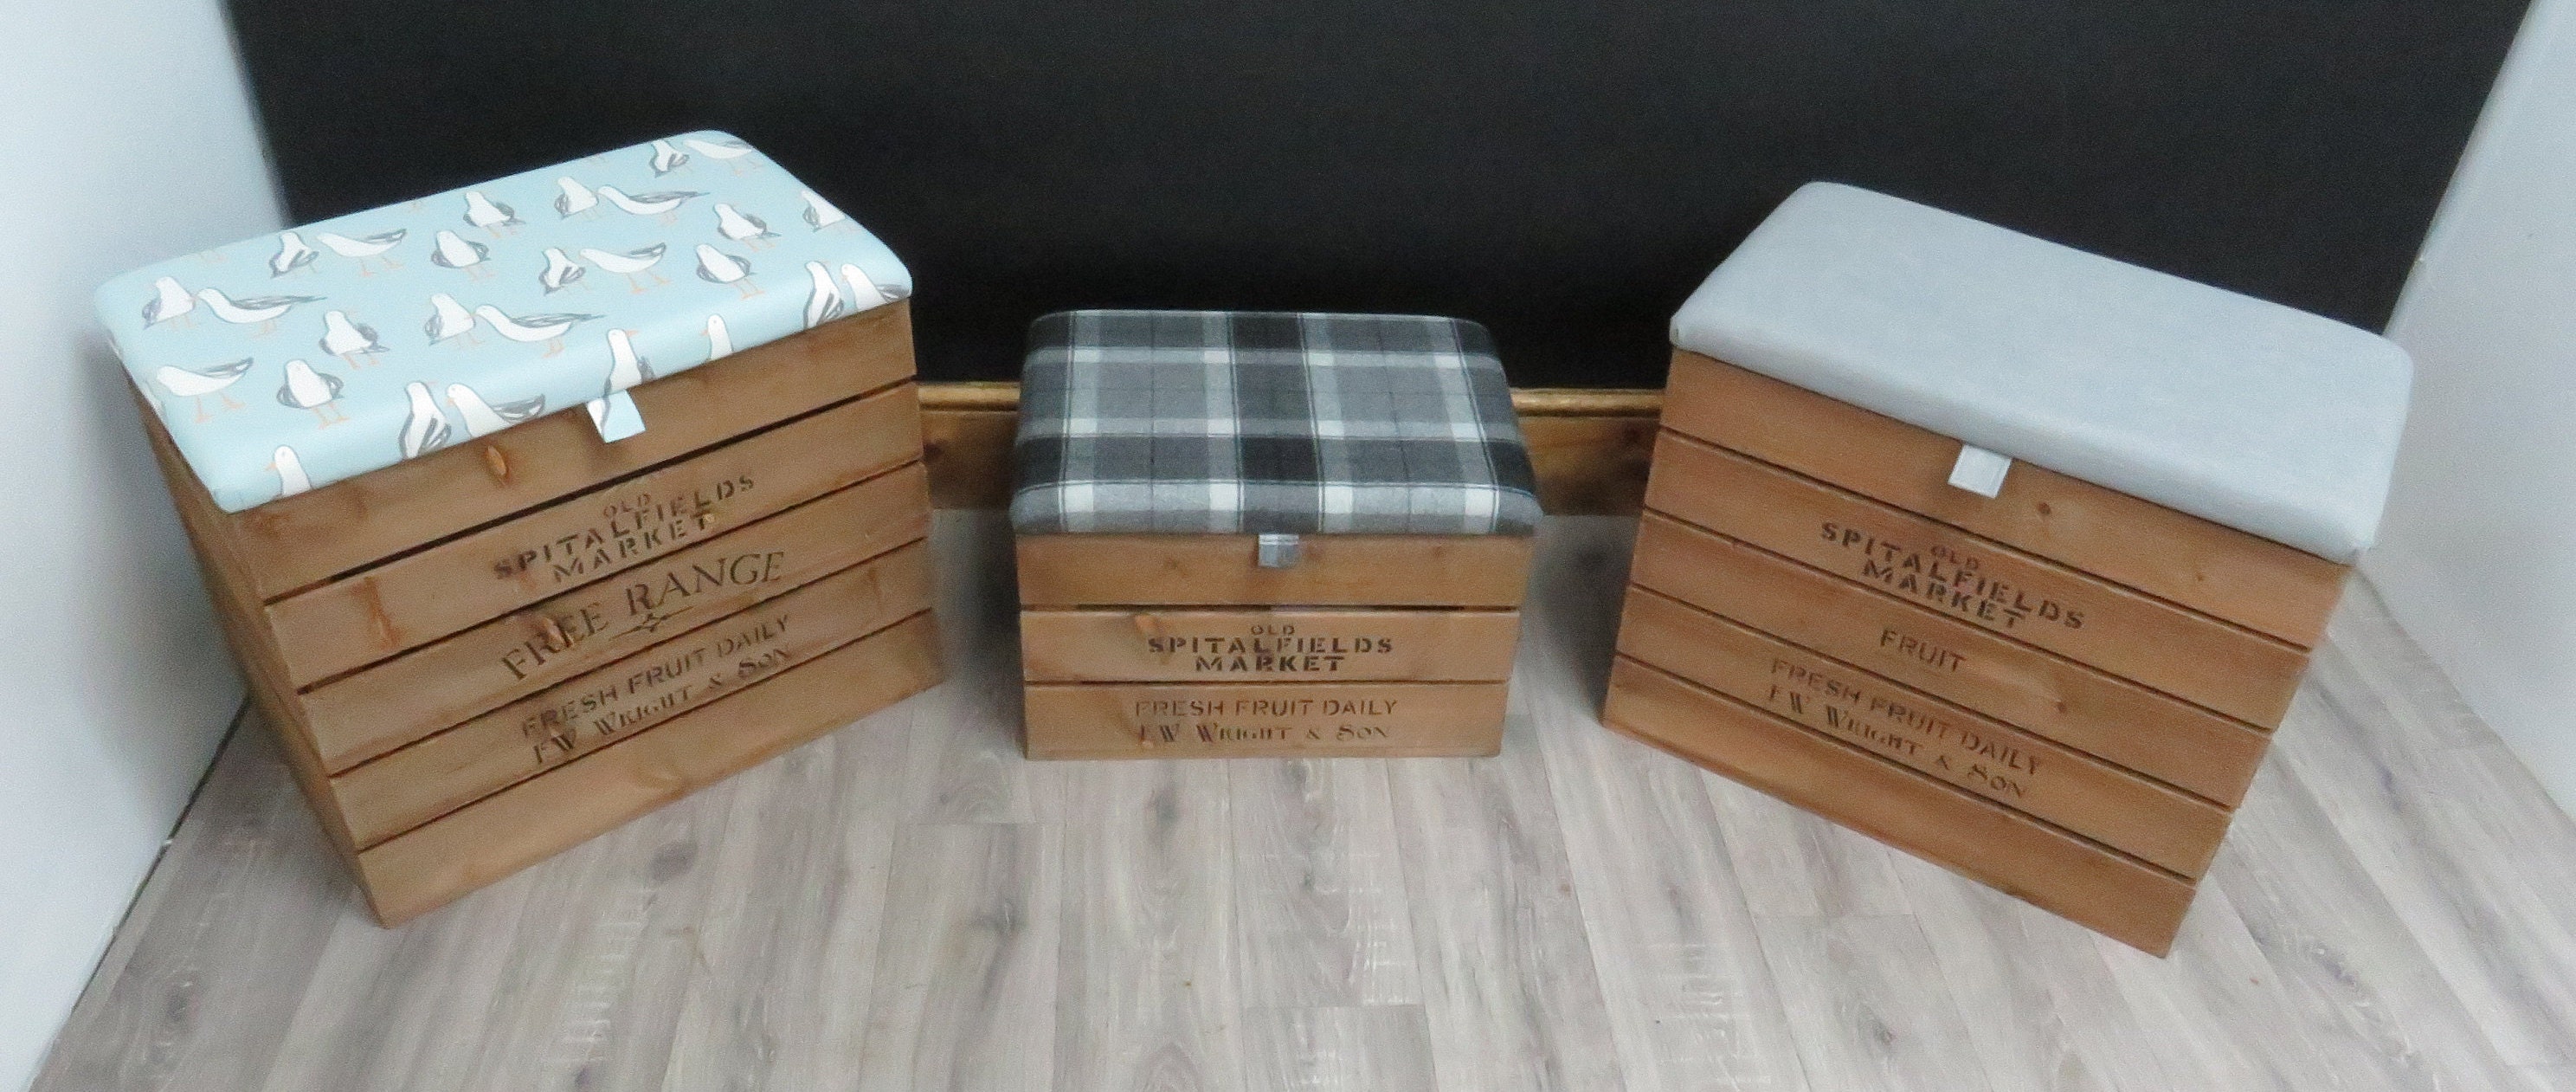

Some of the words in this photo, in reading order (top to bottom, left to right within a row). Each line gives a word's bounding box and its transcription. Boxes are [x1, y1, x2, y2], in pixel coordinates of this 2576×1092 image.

[493, 475, 754, 579] SPITALFIELDS
[602, 493, 651, 518] OLD
[552, 511, 715, 582] MARKET
[1930, 545, 1979, 571] OLD
[1820, 521, 2085, 630] SPITALFIELDS
[1861, 559, 2025, 630] MARKET
[501, 601, 609, 681] FREE
[625, 551, 784, 617] RANGE
[1250, 624, 1296, 636] OLD
[1148, 636, 1393, 654] SPITALFIELDS
[1195, 656, 1344, 673] MARKET
[1879, 630, 1967, 673] FRUIT
[522, 681, 619, 738] FRESH
[628, 647, 707, 695] FRUIT
[717, 614, 789, 658] DAILY
[1136, 700, 1224, 717] FRESH
[1235, 699, 1314, 717] FRUIT
[1322, 699, 1399, 716] DAILY
[1770, 656, 1860, 704] FRESH
[1870, 698, 1955, 740] FRUIT
[1961, 725, 2045, 775] DAILY
